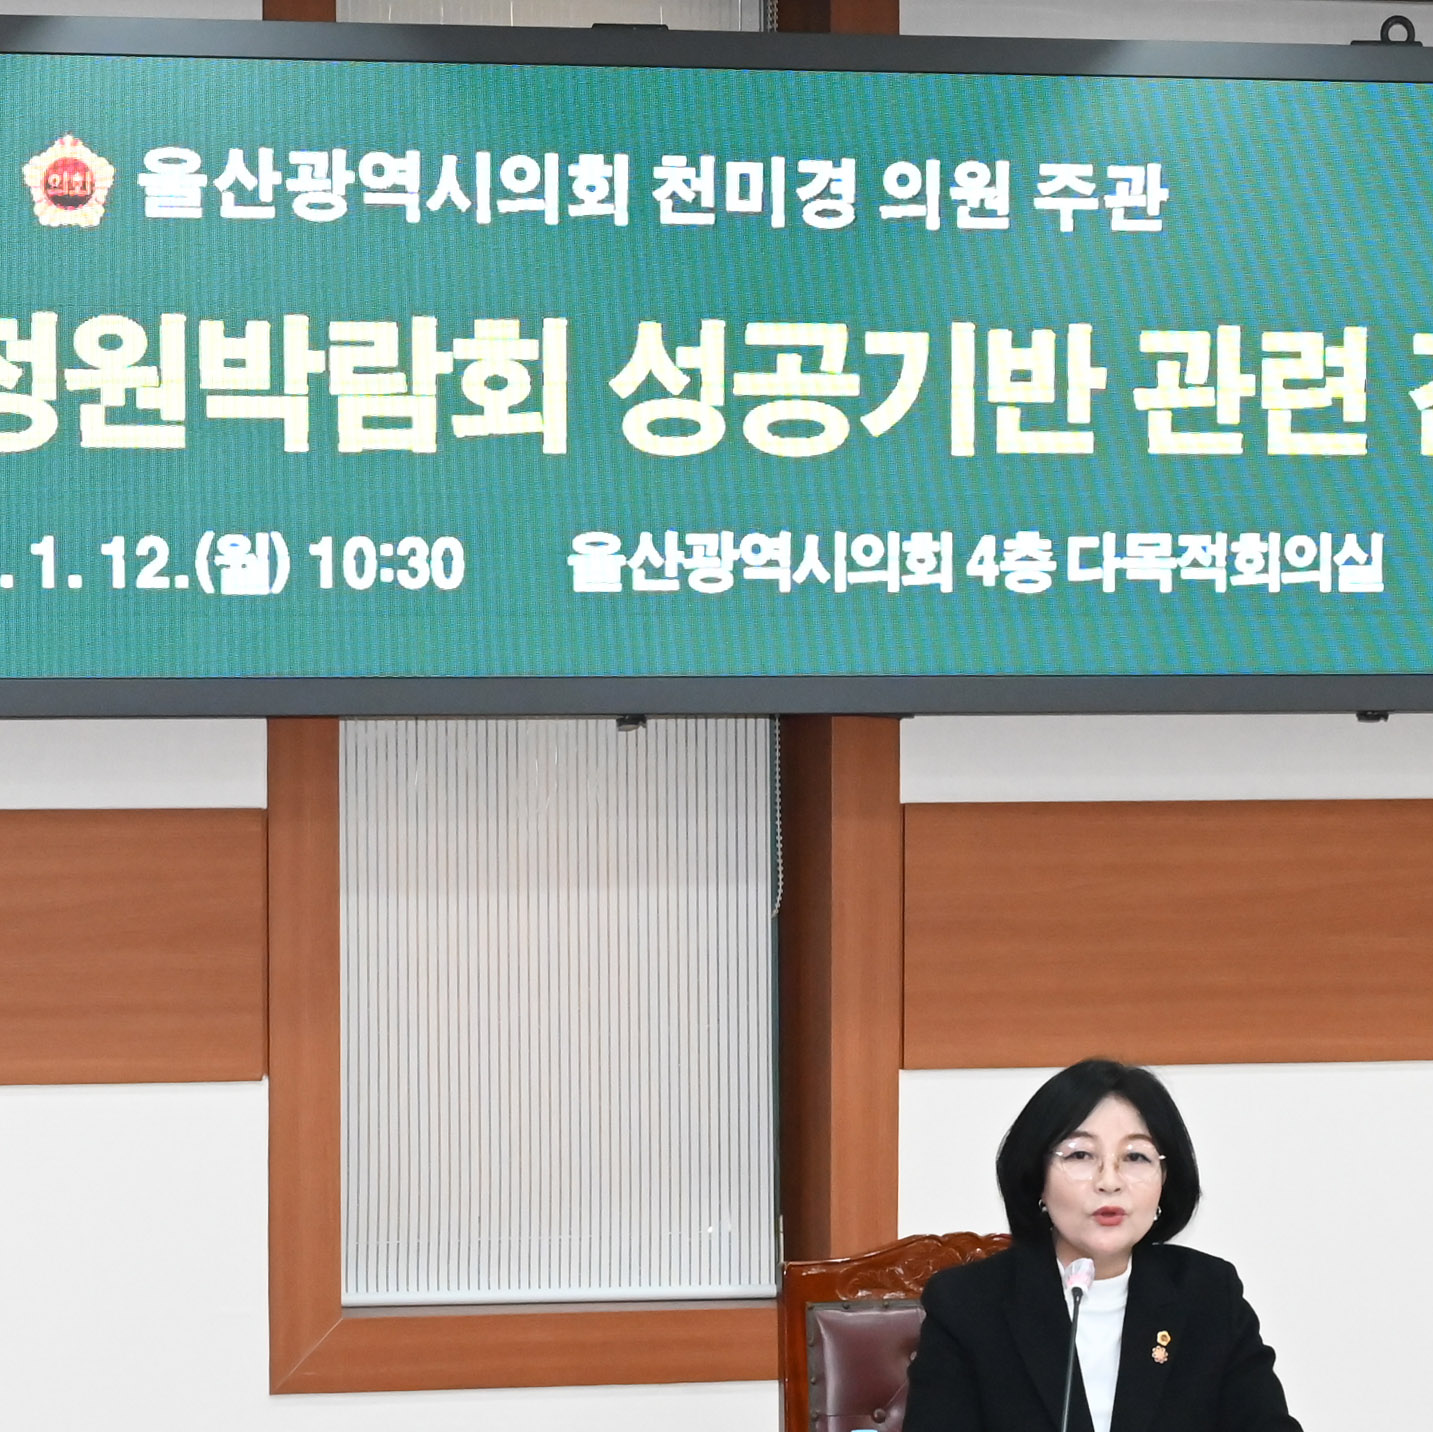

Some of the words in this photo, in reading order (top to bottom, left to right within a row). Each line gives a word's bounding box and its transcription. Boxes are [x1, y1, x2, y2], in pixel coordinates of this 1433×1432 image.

[136, 146, 630, 228] 울산광역시의회
[652, 155, 858, 231] 천미경
[879, 159, 1012, 232] 의원
[1033, 163, 1171, 234] 주관
[609, 318, 1110, 460] 성공기반
[1133, 324, 1370, 458] 관련
[308, 535, 467, 592] 10:30
[567, 530, 955, 596] 울산광역시의회
[966, 530, 1059, 596] 4층
[1067, 531, 1387, 596] 다목적회의실
